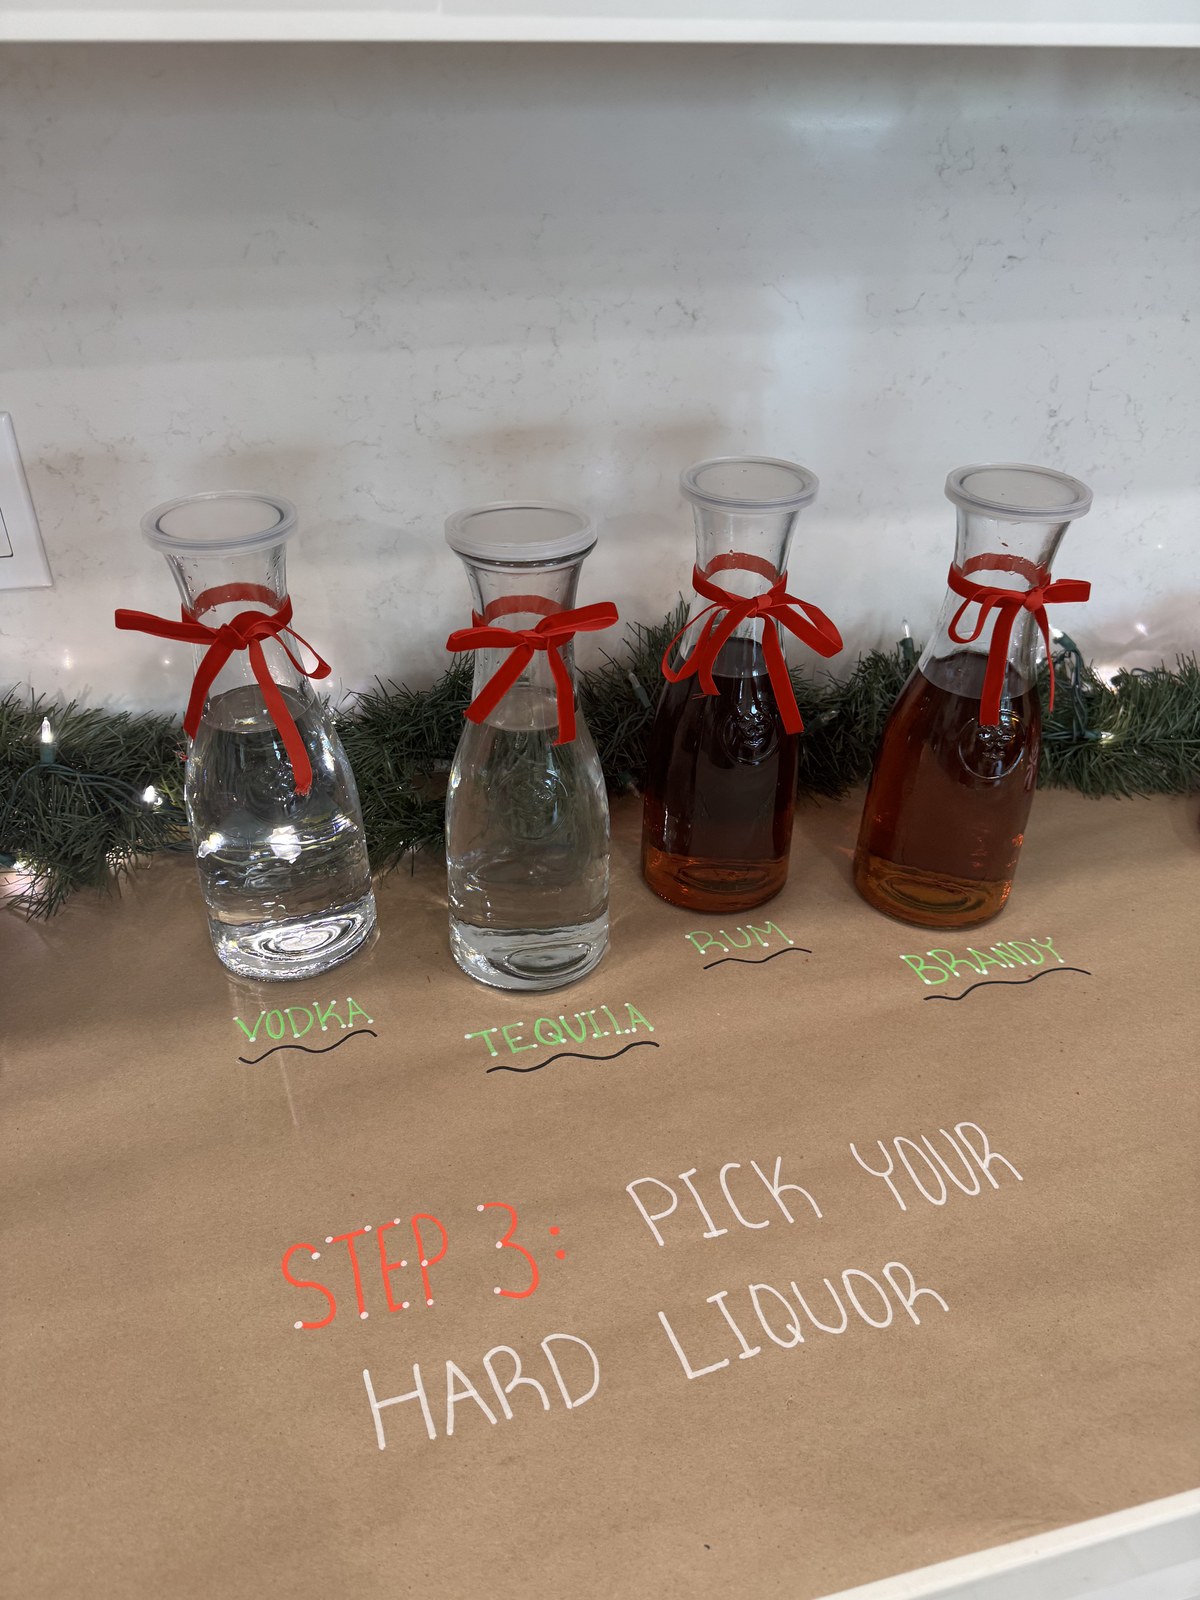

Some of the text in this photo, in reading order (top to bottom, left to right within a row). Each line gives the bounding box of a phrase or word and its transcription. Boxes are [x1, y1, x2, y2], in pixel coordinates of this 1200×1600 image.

[684, 920, 794, 955] RUM
[899, 936, 1065, 985] BRANDY
[232, 997, 374, 1042] VODKA
[464, 1002, 655, 1057] TEQUILA
[281, 1122, 1024, 1330] STEP 3: PICK YOUR
[363, 1261, 949, 1450] HARD LIQUOR
